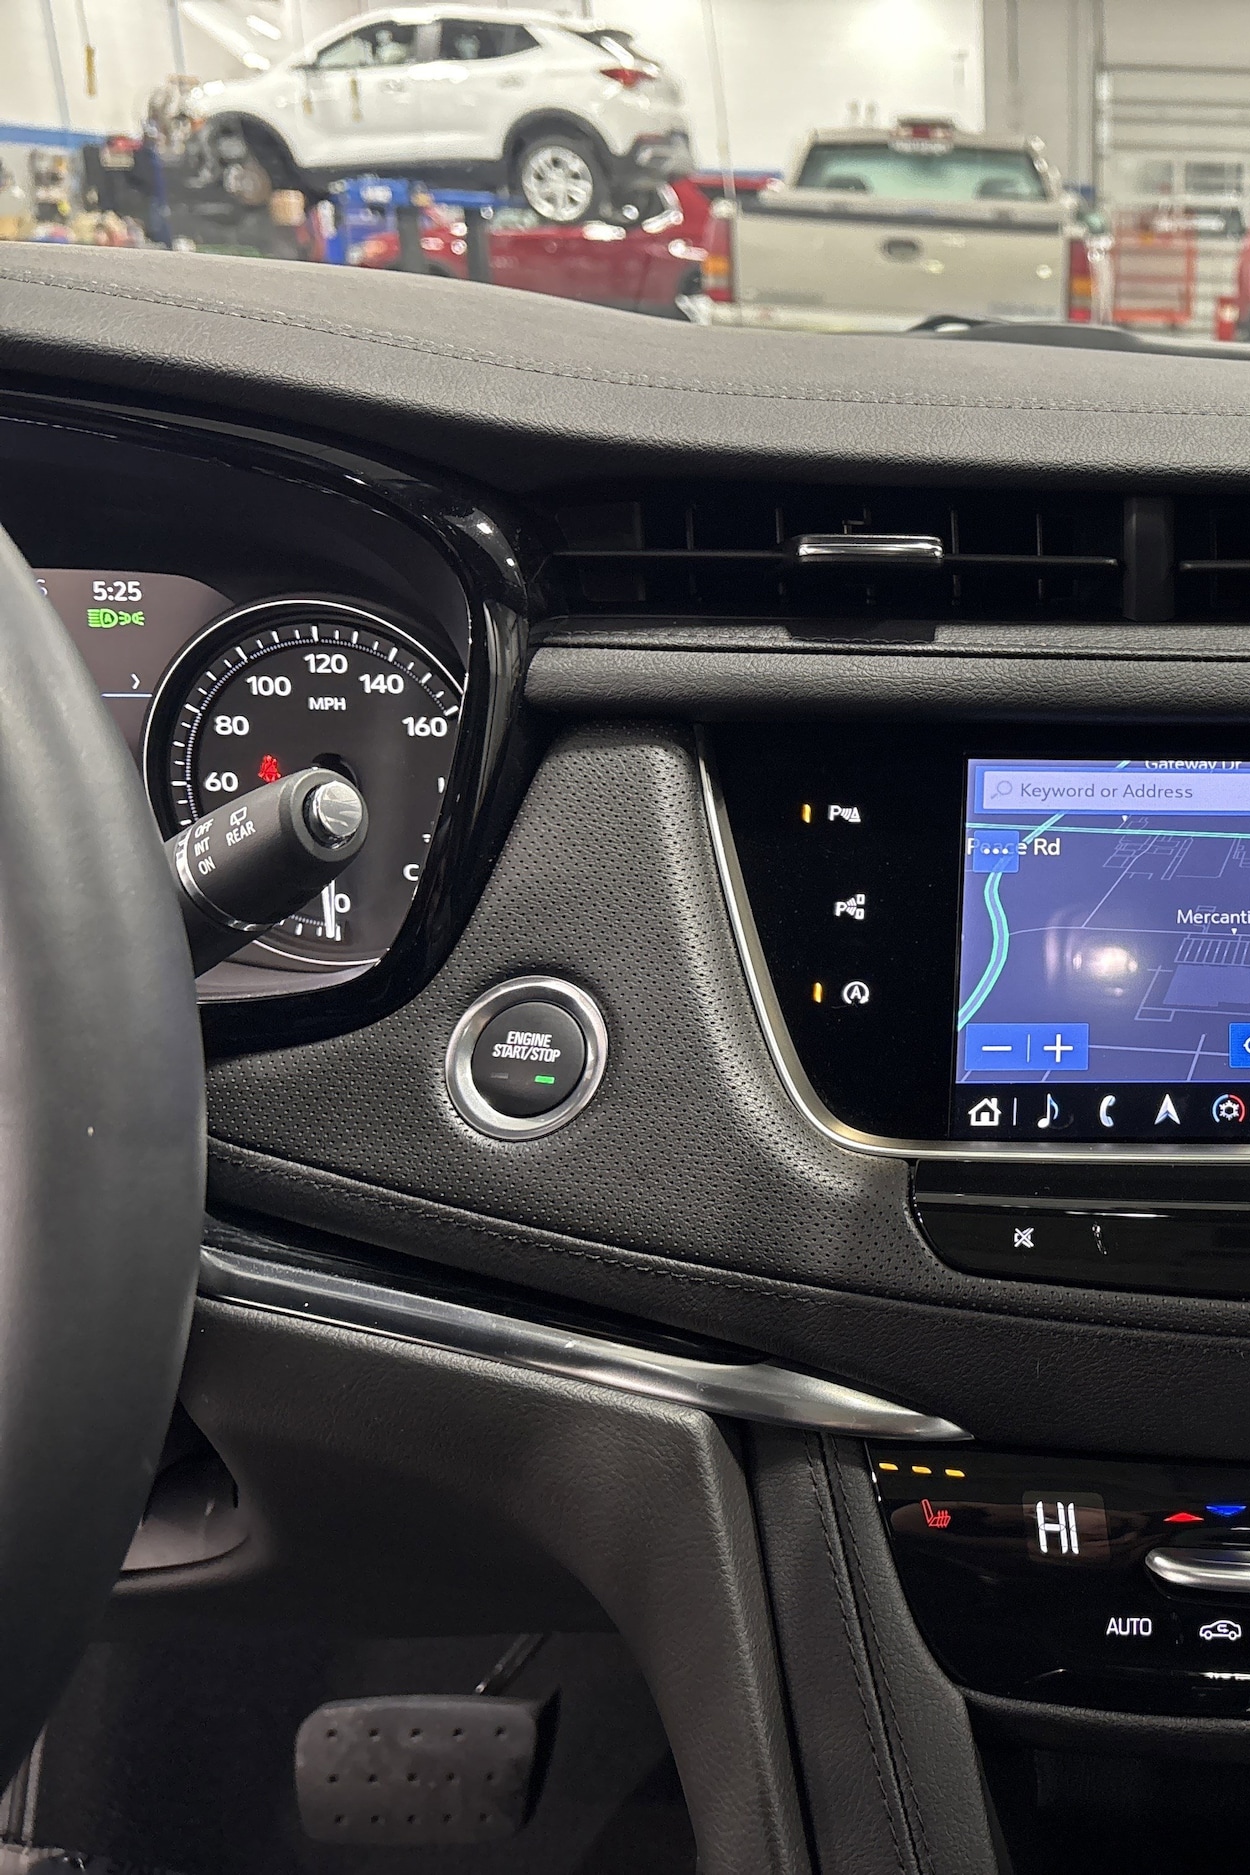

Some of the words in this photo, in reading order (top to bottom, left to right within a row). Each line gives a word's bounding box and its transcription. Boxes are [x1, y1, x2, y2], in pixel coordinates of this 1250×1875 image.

[92, 580, 142, 602] 5:25
[303, 653, 348, 675] 120
[246, 675, 291, 697] 100
[359, 673, 404, 695] 140
[308, 696, 346, 712] MPH
[214, 716, 249, 737] 80
[402, 716, 447, 738] 160
[205, 771, 238, 793] 60
[1020, 783, 1096, 801] Keyword
[1100, 787, 1119, 798] or
[1122, 784, 1194, 799] Address
[194, 818, 214, 838] OFF
[225, 820, 256, 847] REAR
[193, 836, 210, 857] INT
[1033, 837, 1061, 856] Rd
[198, 856, 216, 875] ON
[506, 1031, 552, 1048] ENGINE
[492, 1043, 561, 1063] START/STOP
[1034, 1499, 1080, 1555] HI
[1105, 1616, 1153, 1637] AUTO
